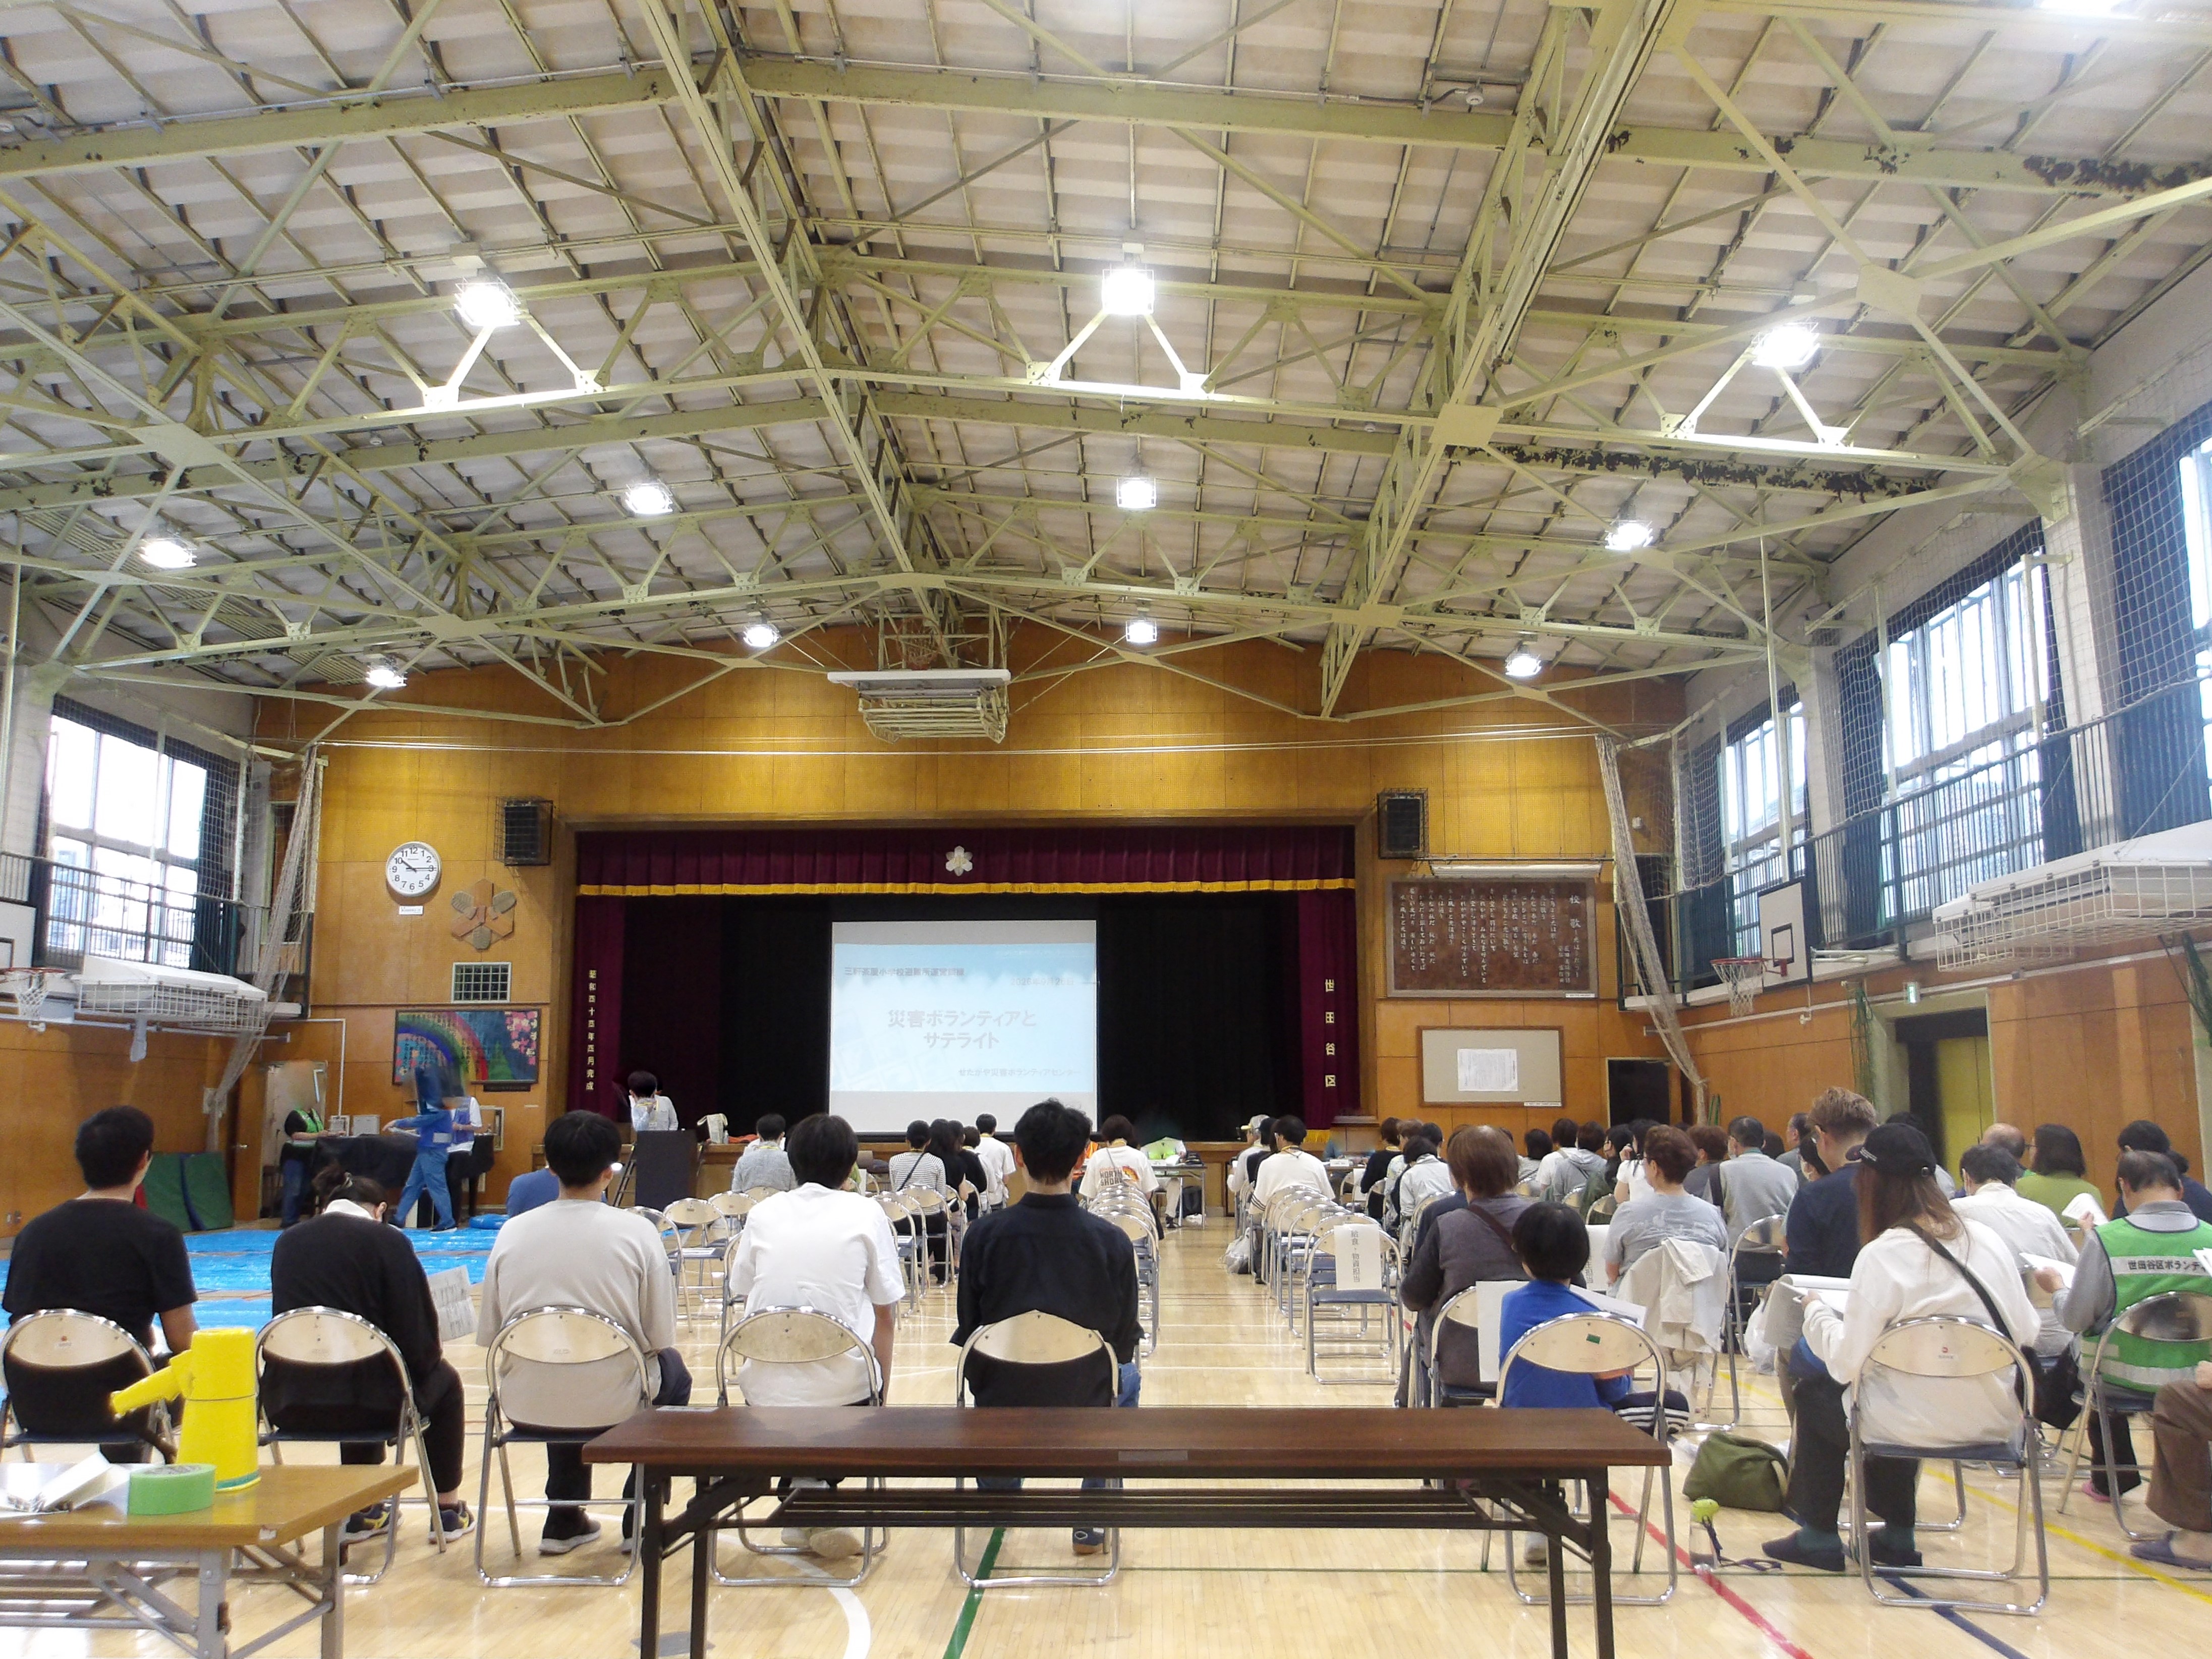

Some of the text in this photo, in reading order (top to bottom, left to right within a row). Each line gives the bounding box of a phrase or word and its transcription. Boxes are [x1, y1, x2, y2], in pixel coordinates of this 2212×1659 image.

[888, 1009, 1037, 1028] 災害ボランティアと
[924, 1032, 1000, 1049] サテライト
[1325, 979, 1336, 1087] 世田谷区
[959, 1068, 1081, 1077] せたがや災害ボランティアセンター
[1100, 1169, 1123, 1179] NORTH
